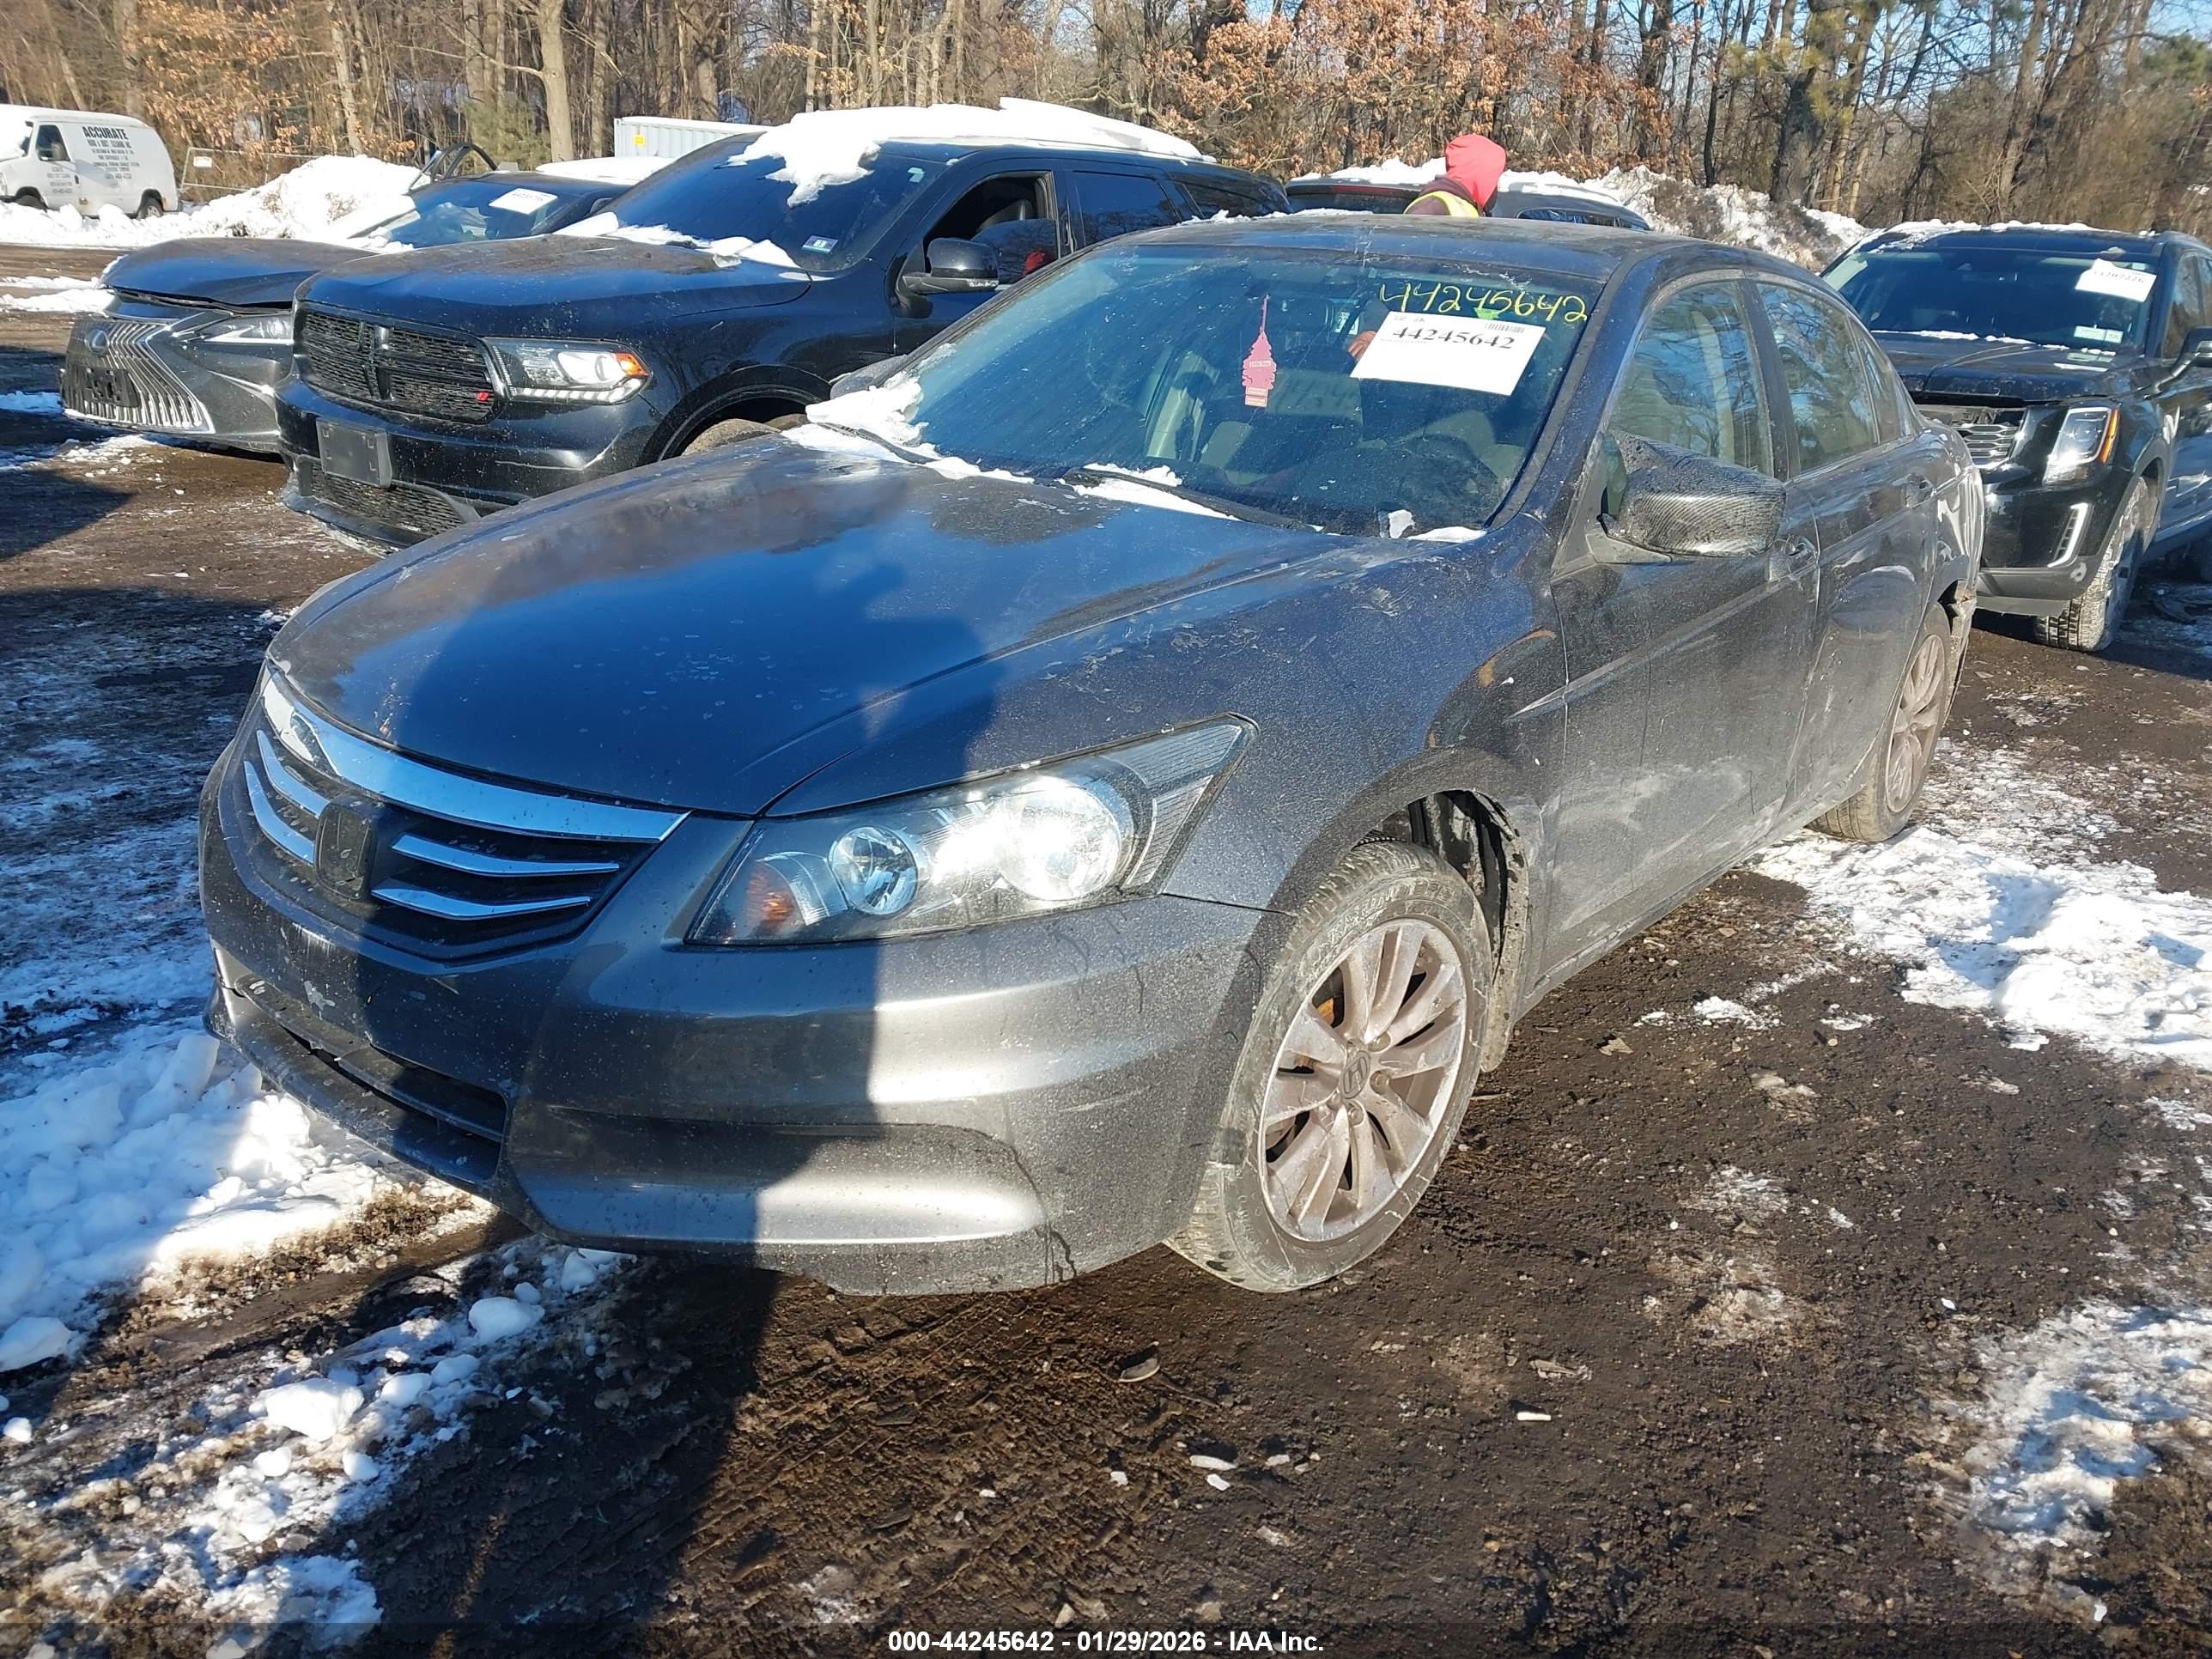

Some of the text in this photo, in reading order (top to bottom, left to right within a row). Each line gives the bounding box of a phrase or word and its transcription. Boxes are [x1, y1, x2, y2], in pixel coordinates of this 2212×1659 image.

[82, 126, 129, 139] ACCURATE
[1379, 282, 1588, 323] 44245642
[1392, 326, 1516, 349] 44245642
